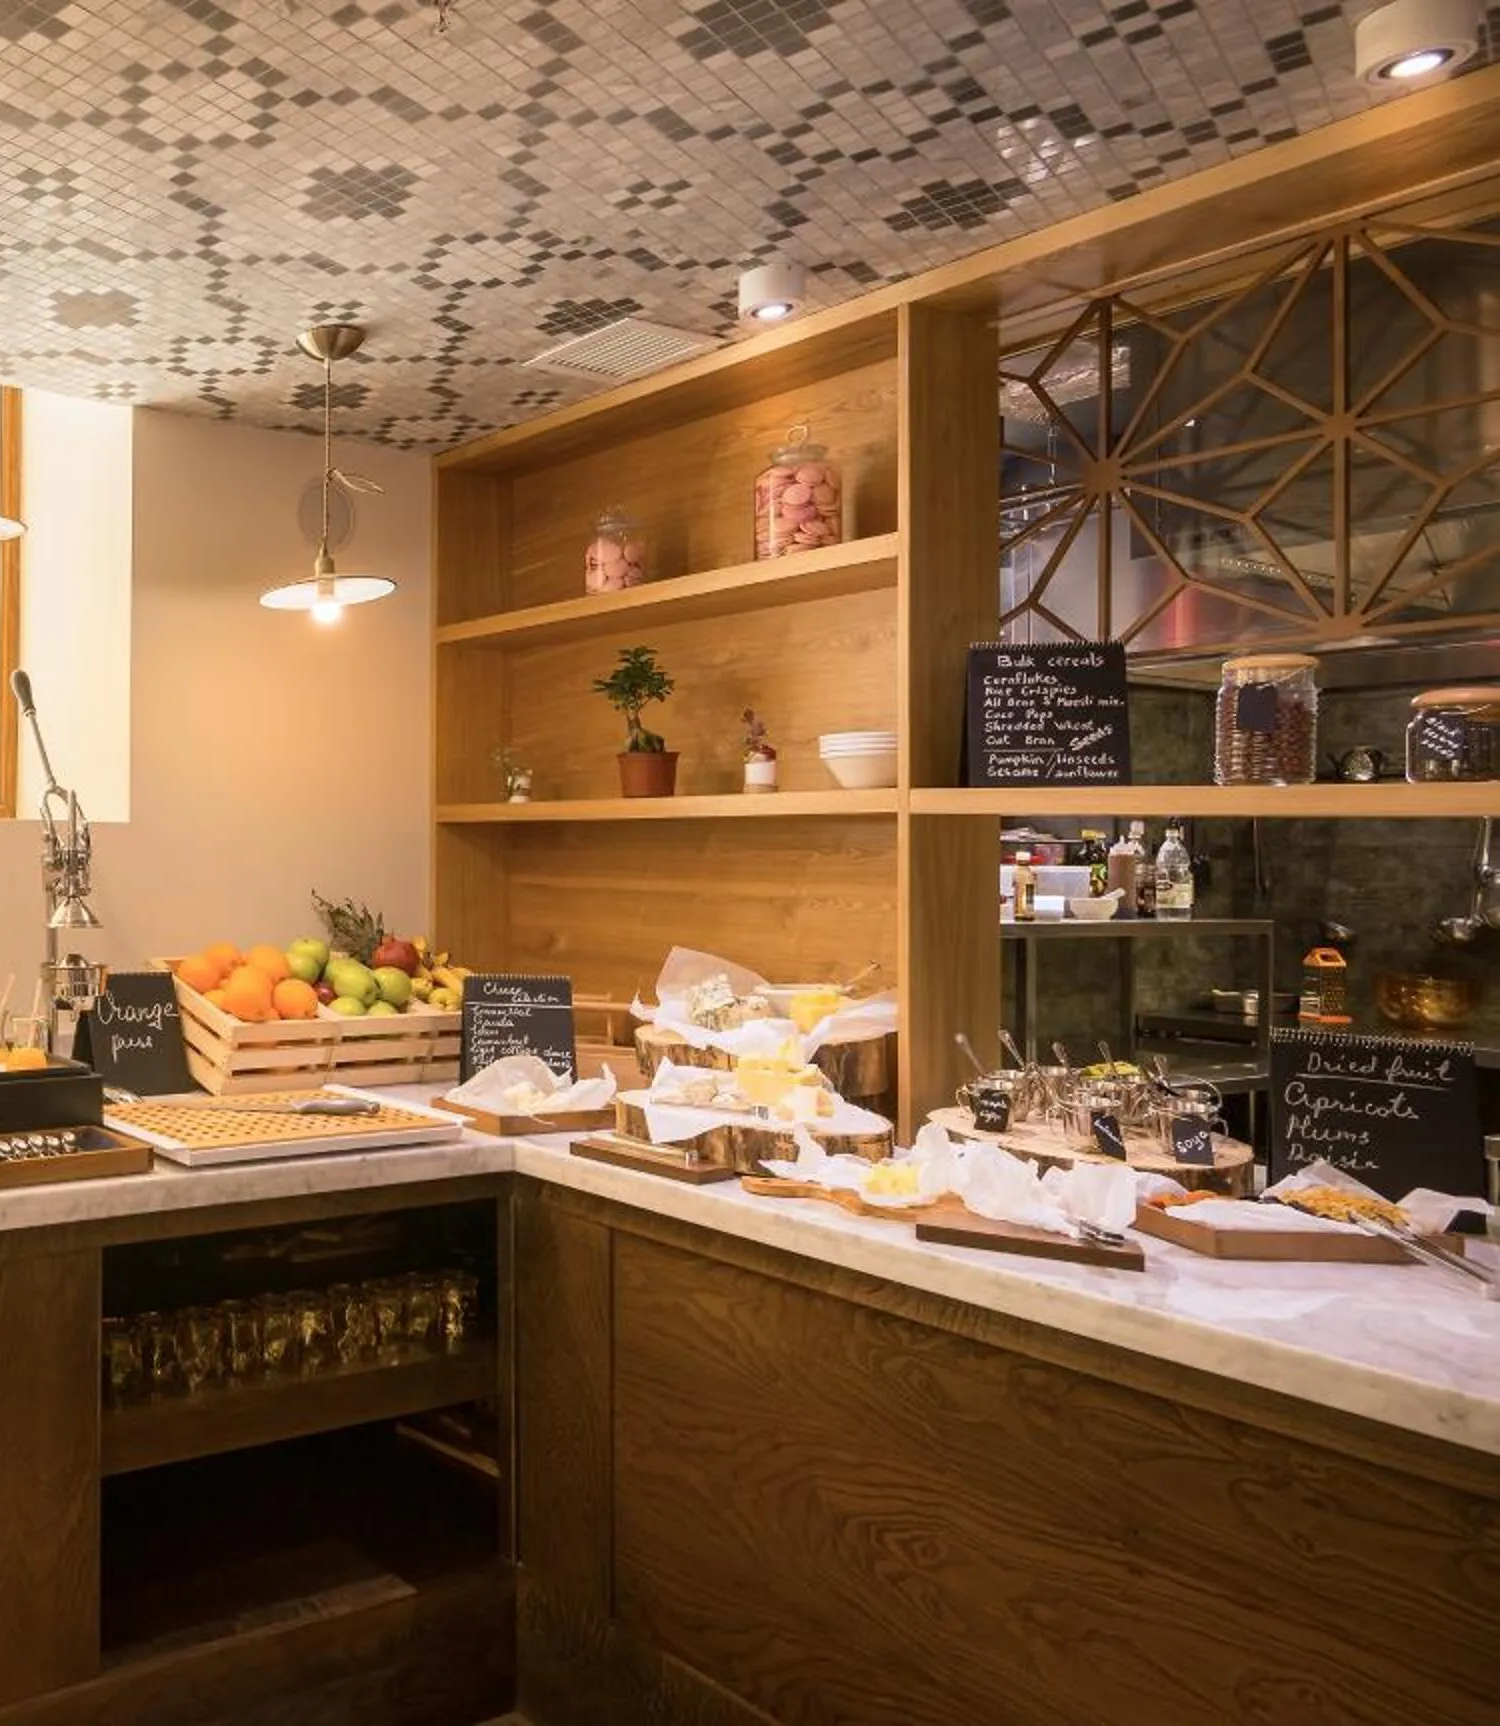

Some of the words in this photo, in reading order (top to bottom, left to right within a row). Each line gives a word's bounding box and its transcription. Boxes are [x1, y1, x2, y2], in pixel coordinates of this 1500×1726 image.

[997, 654, 1036, 667] Bulk
[1047, 652, 1104, 667] cereals
[983, 672, 1058, 685] Cornflakes
[984, 697, 1001, 707] All
[1025, 735, 1055, 745] Bran
[97, 989, 179, 1030] Orange
[1306, 1051, 1377, 1073] Dried
[1385, 1055, 1456, 1083] fruit
[1286, 1114, 1370, 1145] Plums
